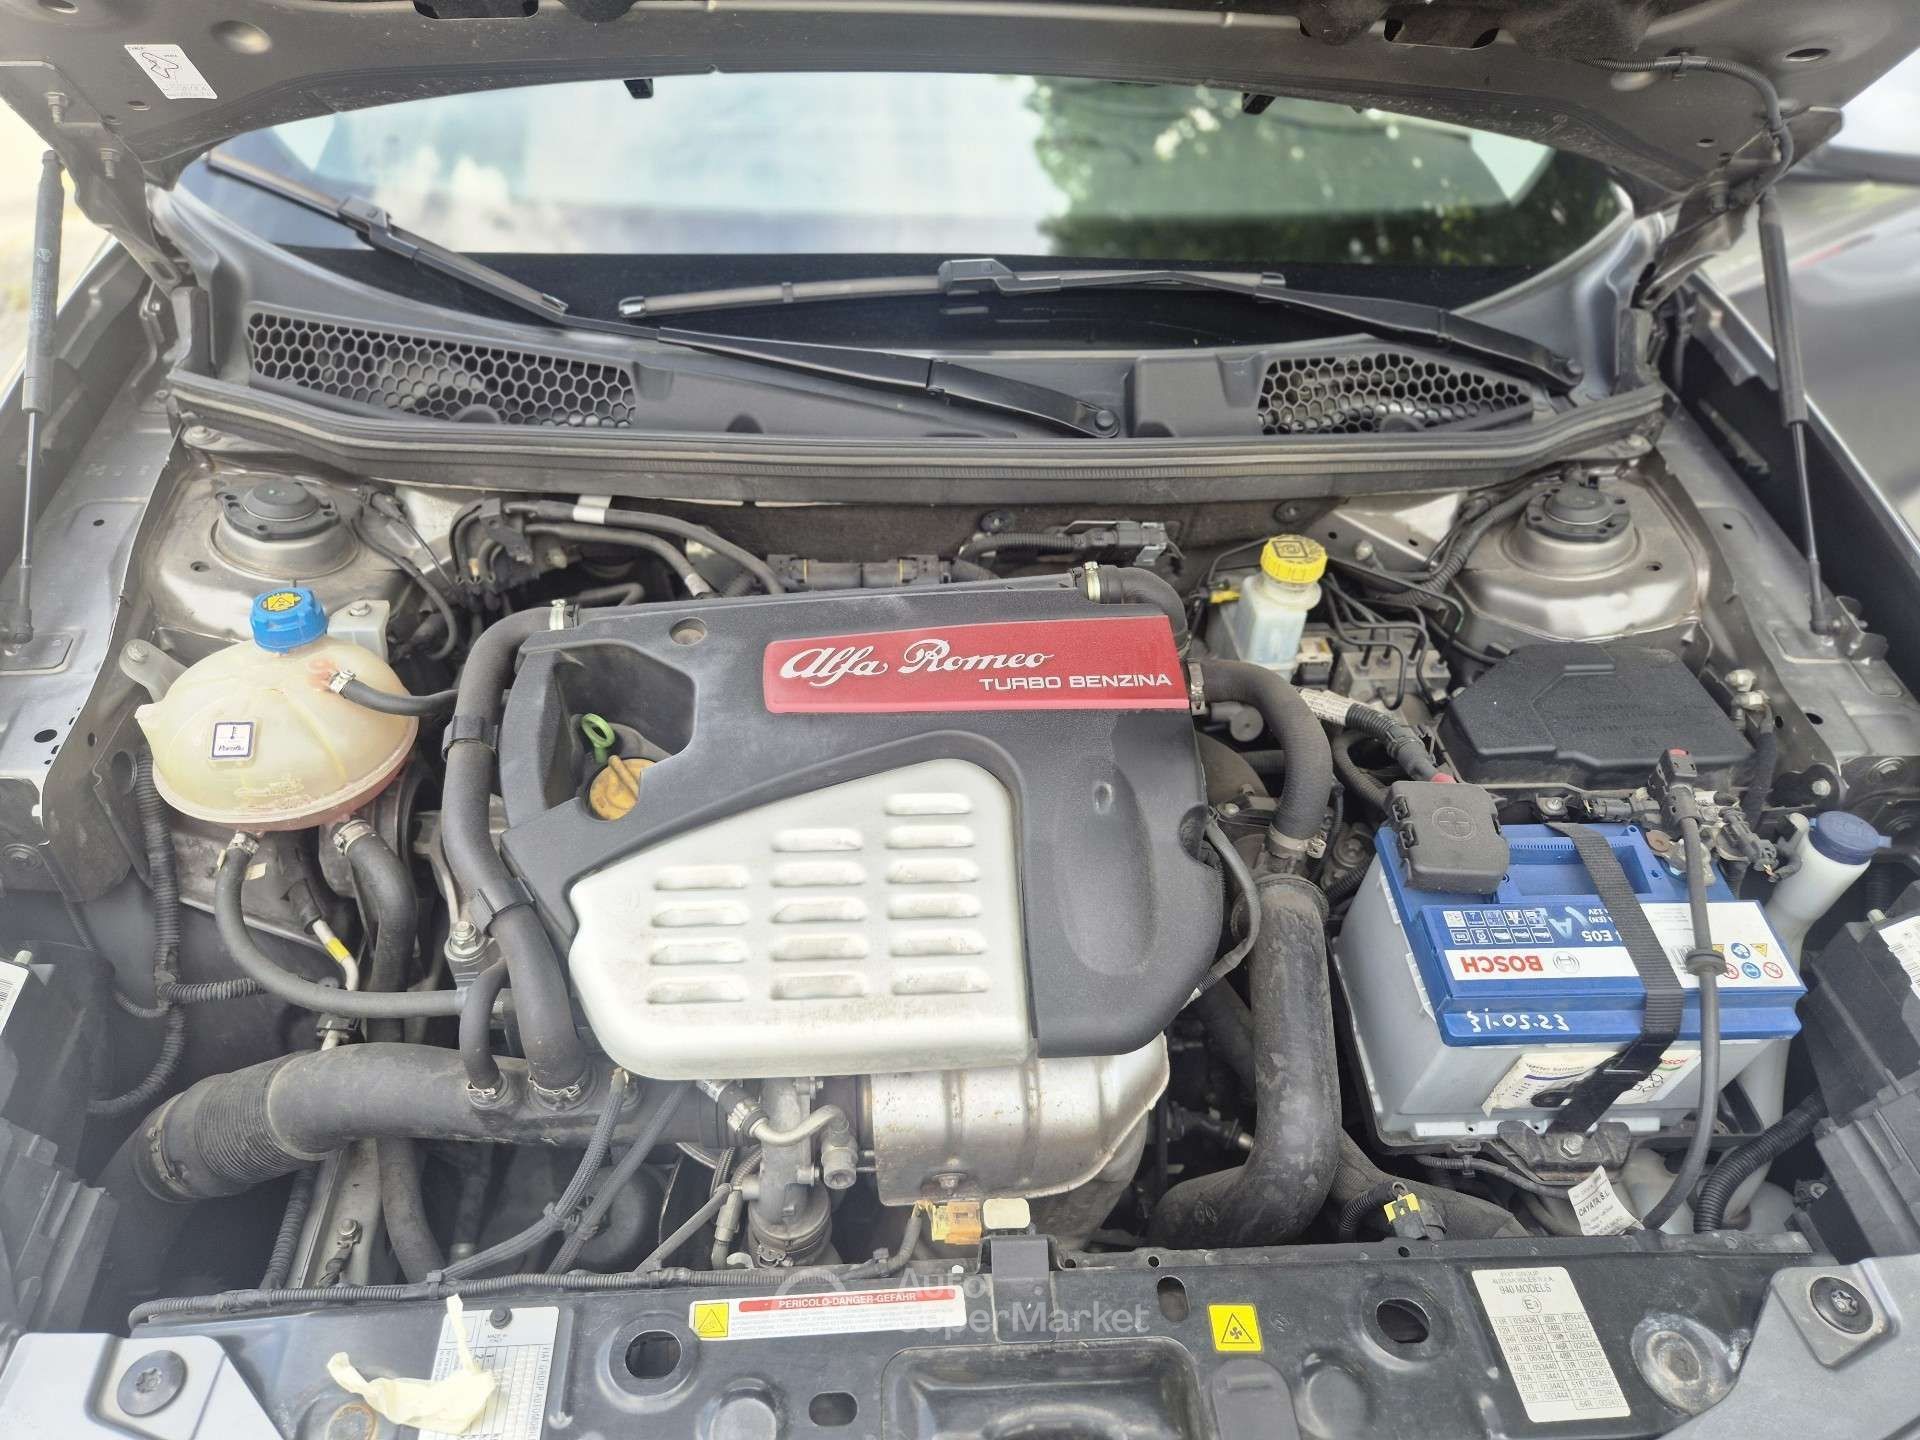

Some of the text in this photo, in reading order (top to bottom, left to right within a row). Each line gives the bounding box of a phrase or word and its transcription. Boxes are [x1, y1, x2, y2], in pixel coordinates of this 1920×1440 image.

[780, 639, 1054, 688] Alfa Romeo
[979, 672, 1173, 691] TURBO BENZINA
[1459, 955, 1544, 973] BOSCH
[1516, 1283, 1552, 1293] MODELS
[778, 1292, 916, 1309] PERICOLO-DANGER-GEFAHR
